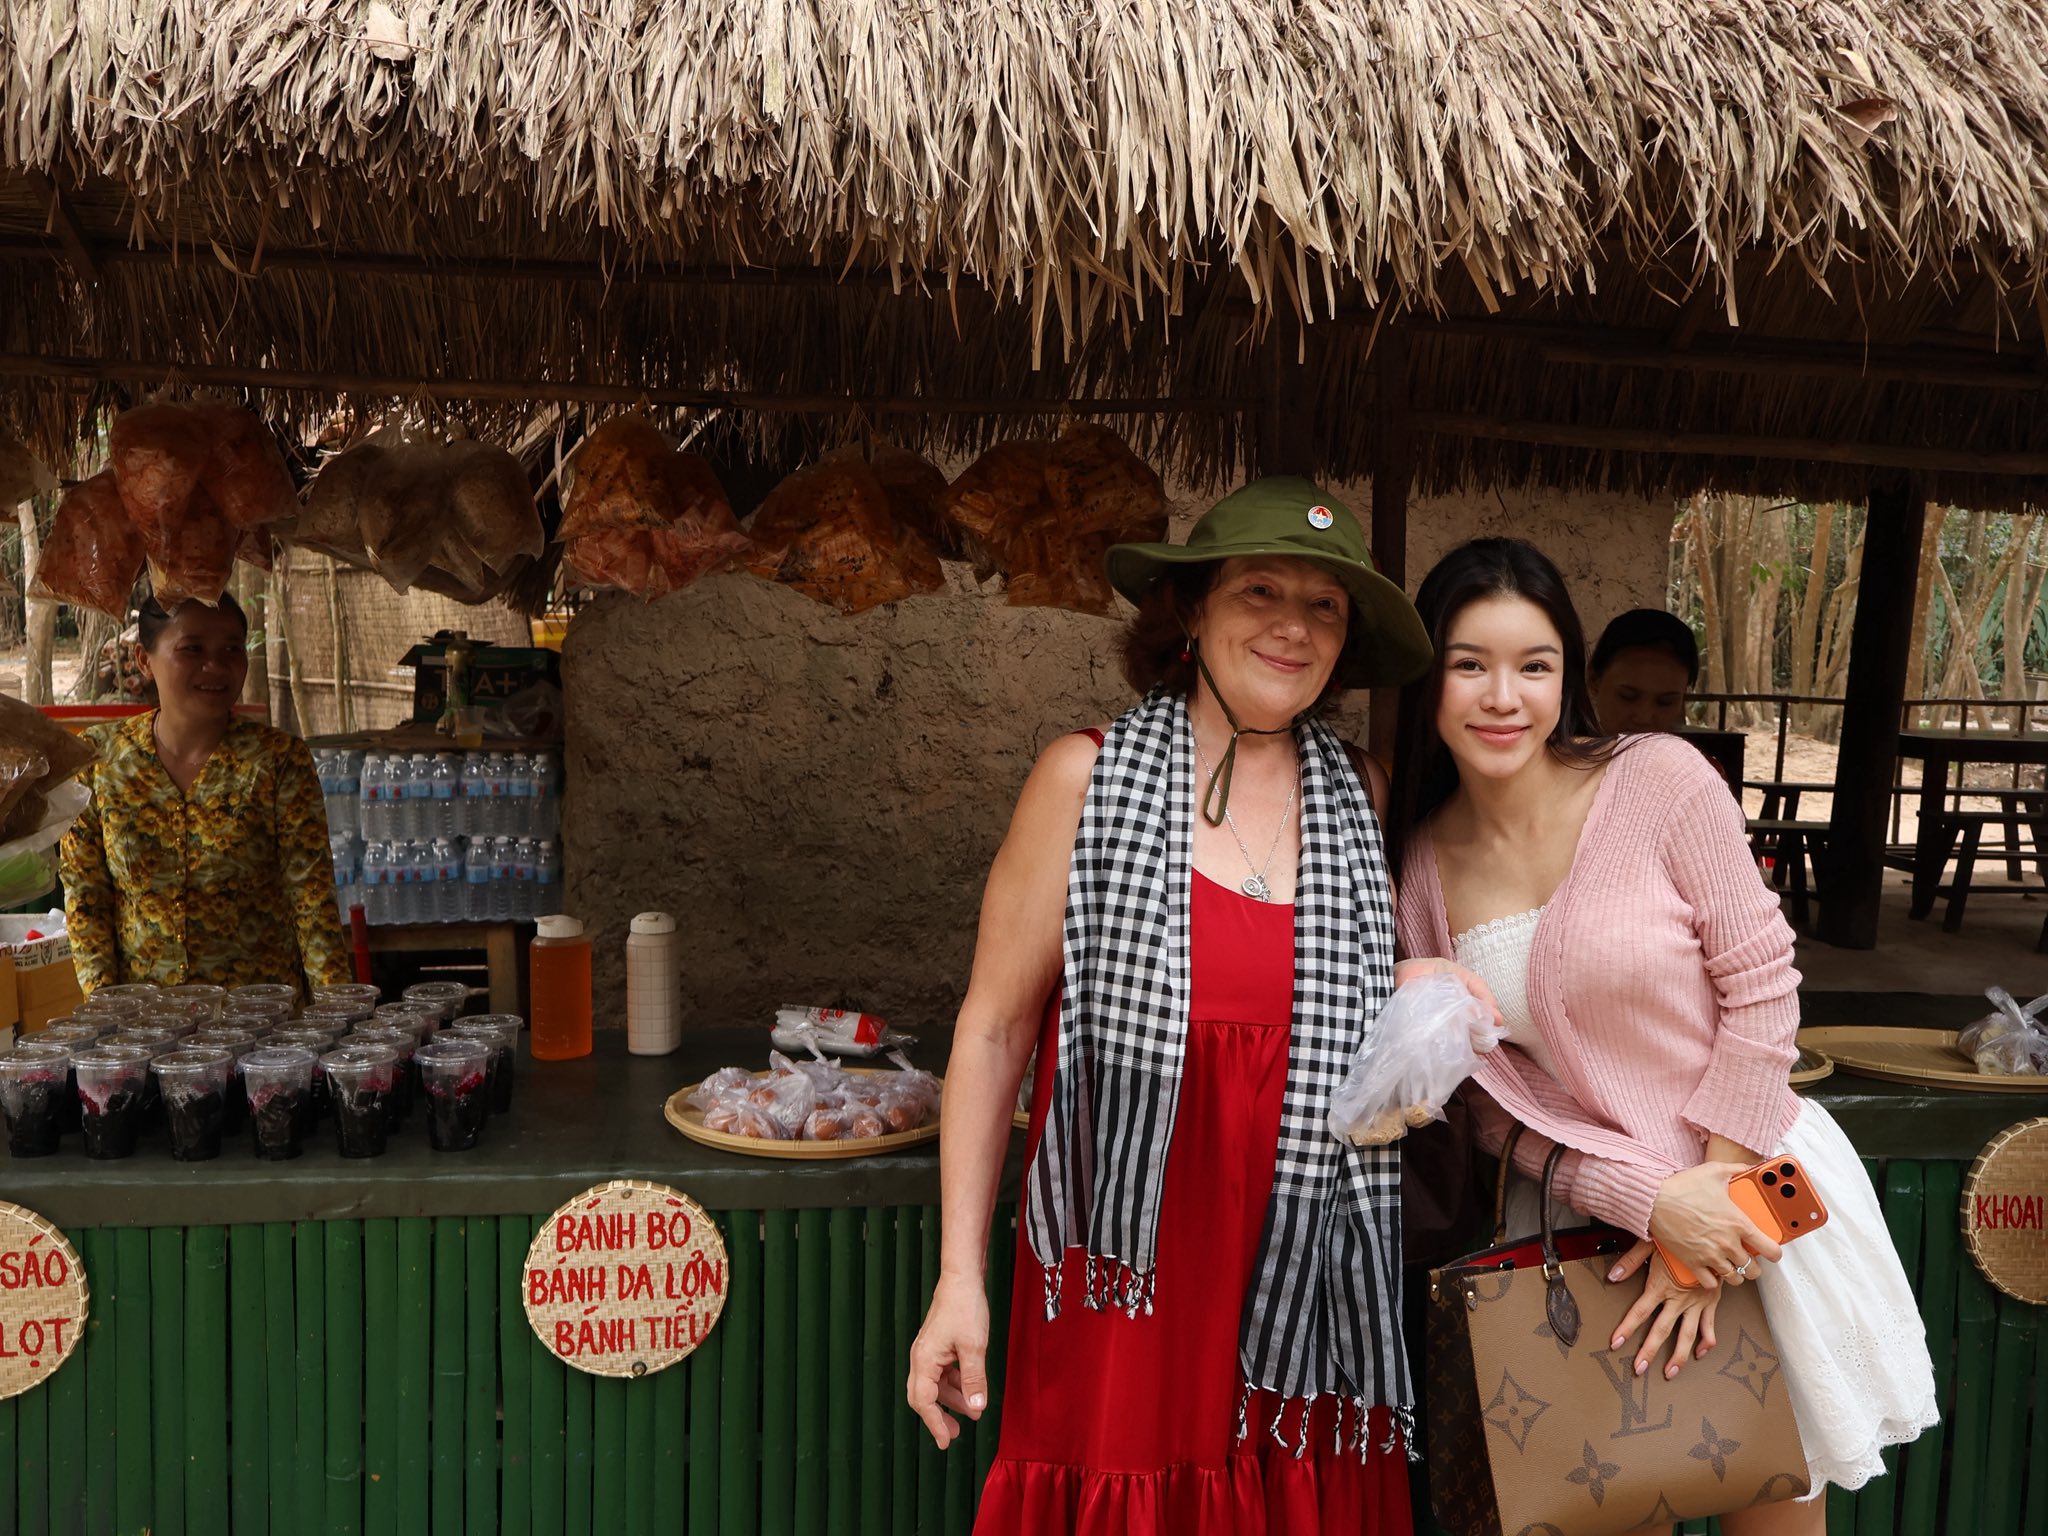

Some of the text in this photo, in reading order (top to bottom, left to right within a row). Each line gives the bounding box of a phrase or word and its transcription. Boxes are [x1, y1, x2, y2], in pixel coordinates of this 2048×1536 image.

[556, 1198, 691, 1253] BÁNH BÒ
[1975, 1194, 2044, 1231] KHOAI
[0, 1233, 68, 1290] SÁO
[528, 1256, 606, 1306] BÁNH
[617, 1263, 655, 1301] DA
[0, 1317, 71, 1368] LỌT
[555, 1305, 635, 1357] BÁNH
